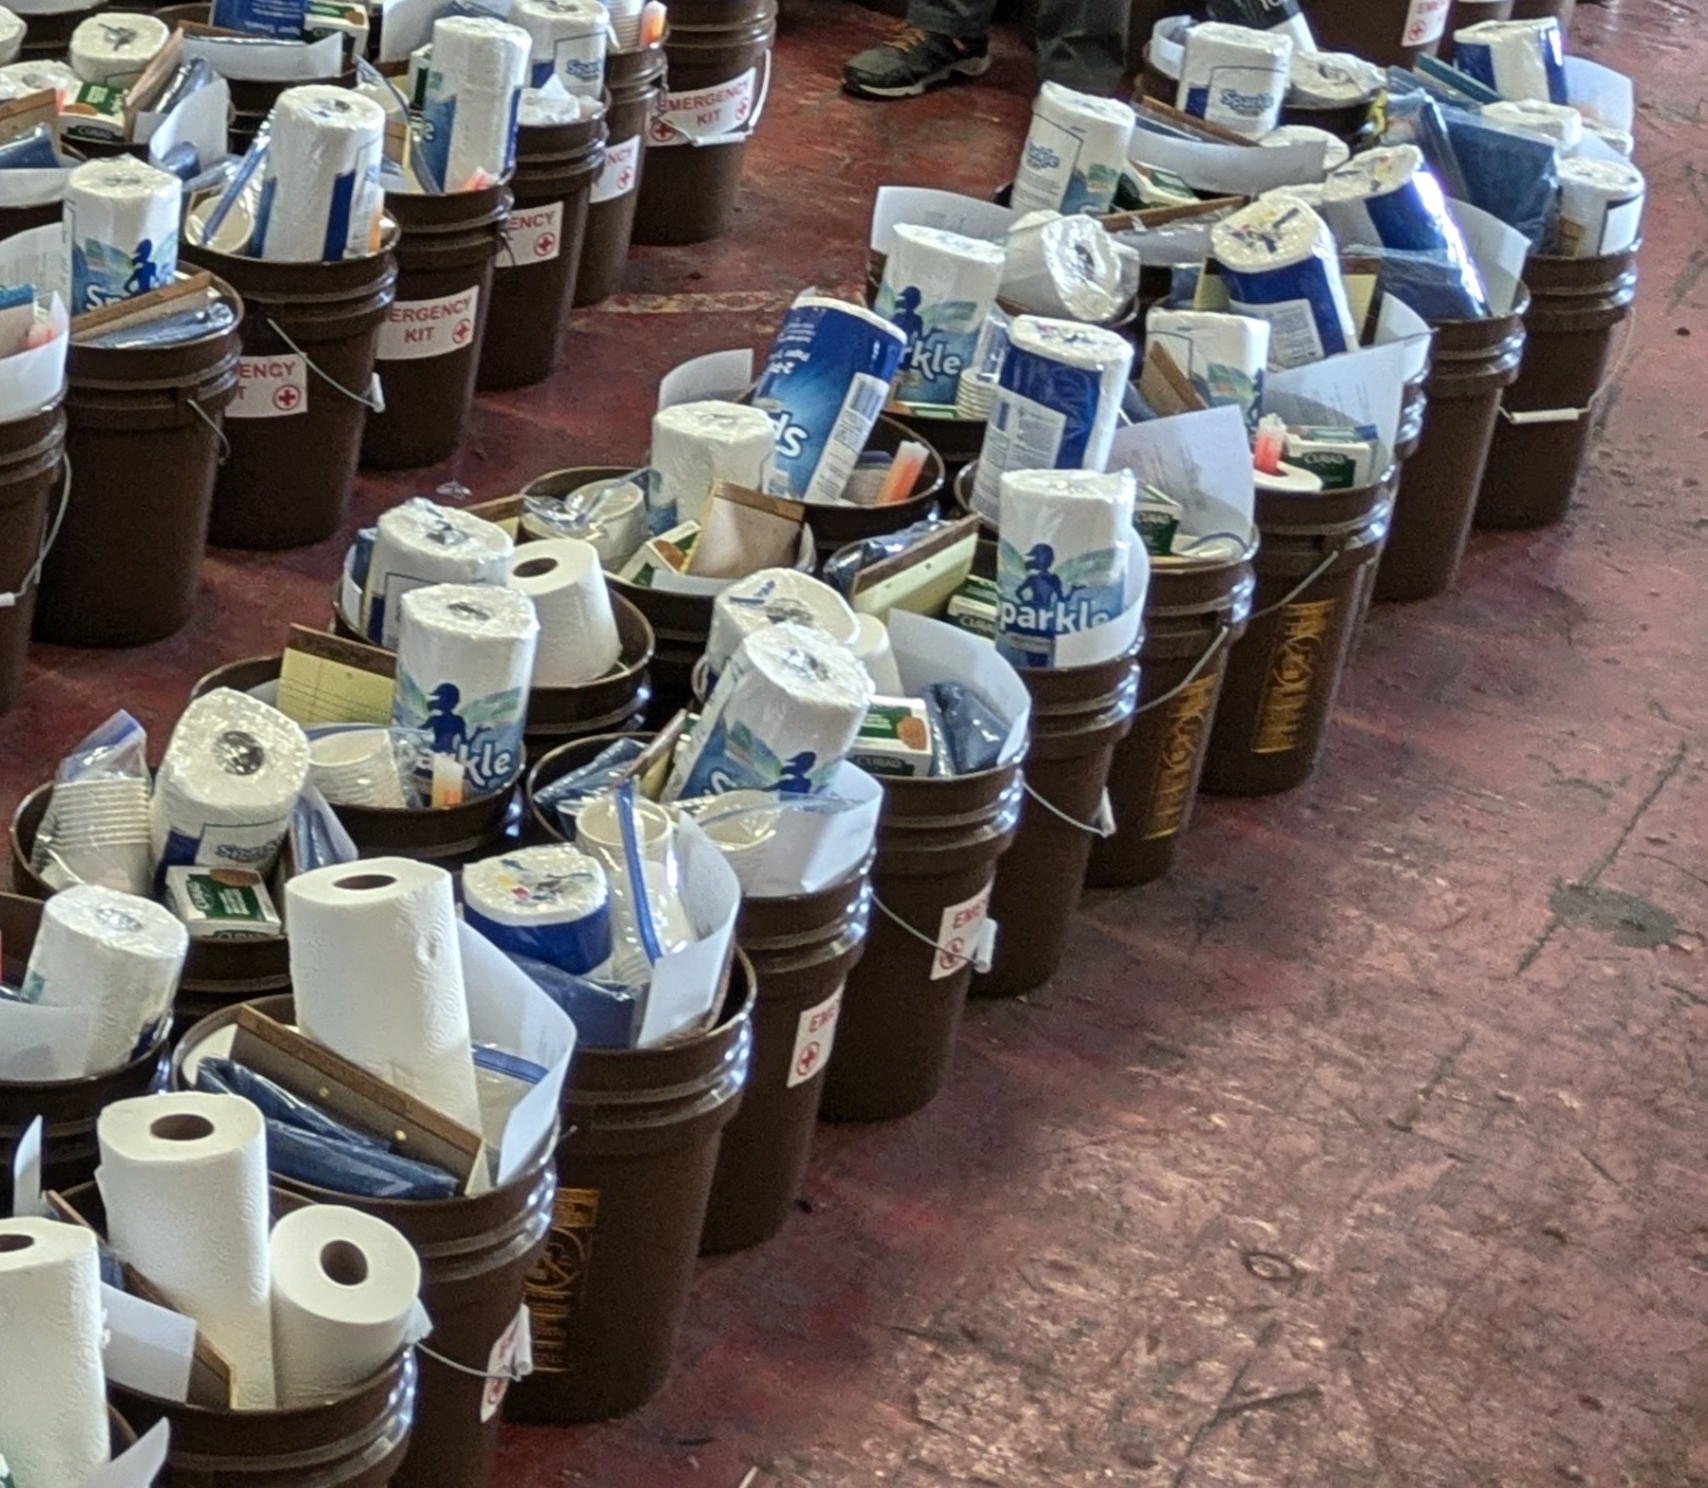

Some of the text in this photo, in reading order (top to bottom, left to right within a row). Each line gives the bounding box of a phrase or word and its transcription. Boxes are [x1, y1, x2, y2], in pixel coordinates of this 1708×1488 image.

[657, 81, 751, 113] EMERGENCY
[697, 109, 720, 126] KIT
[390, 298, 471, 324] ERGENCY
[405, 327, 435, 344] KIT
[1000, 600, 1110, 632] parkle
